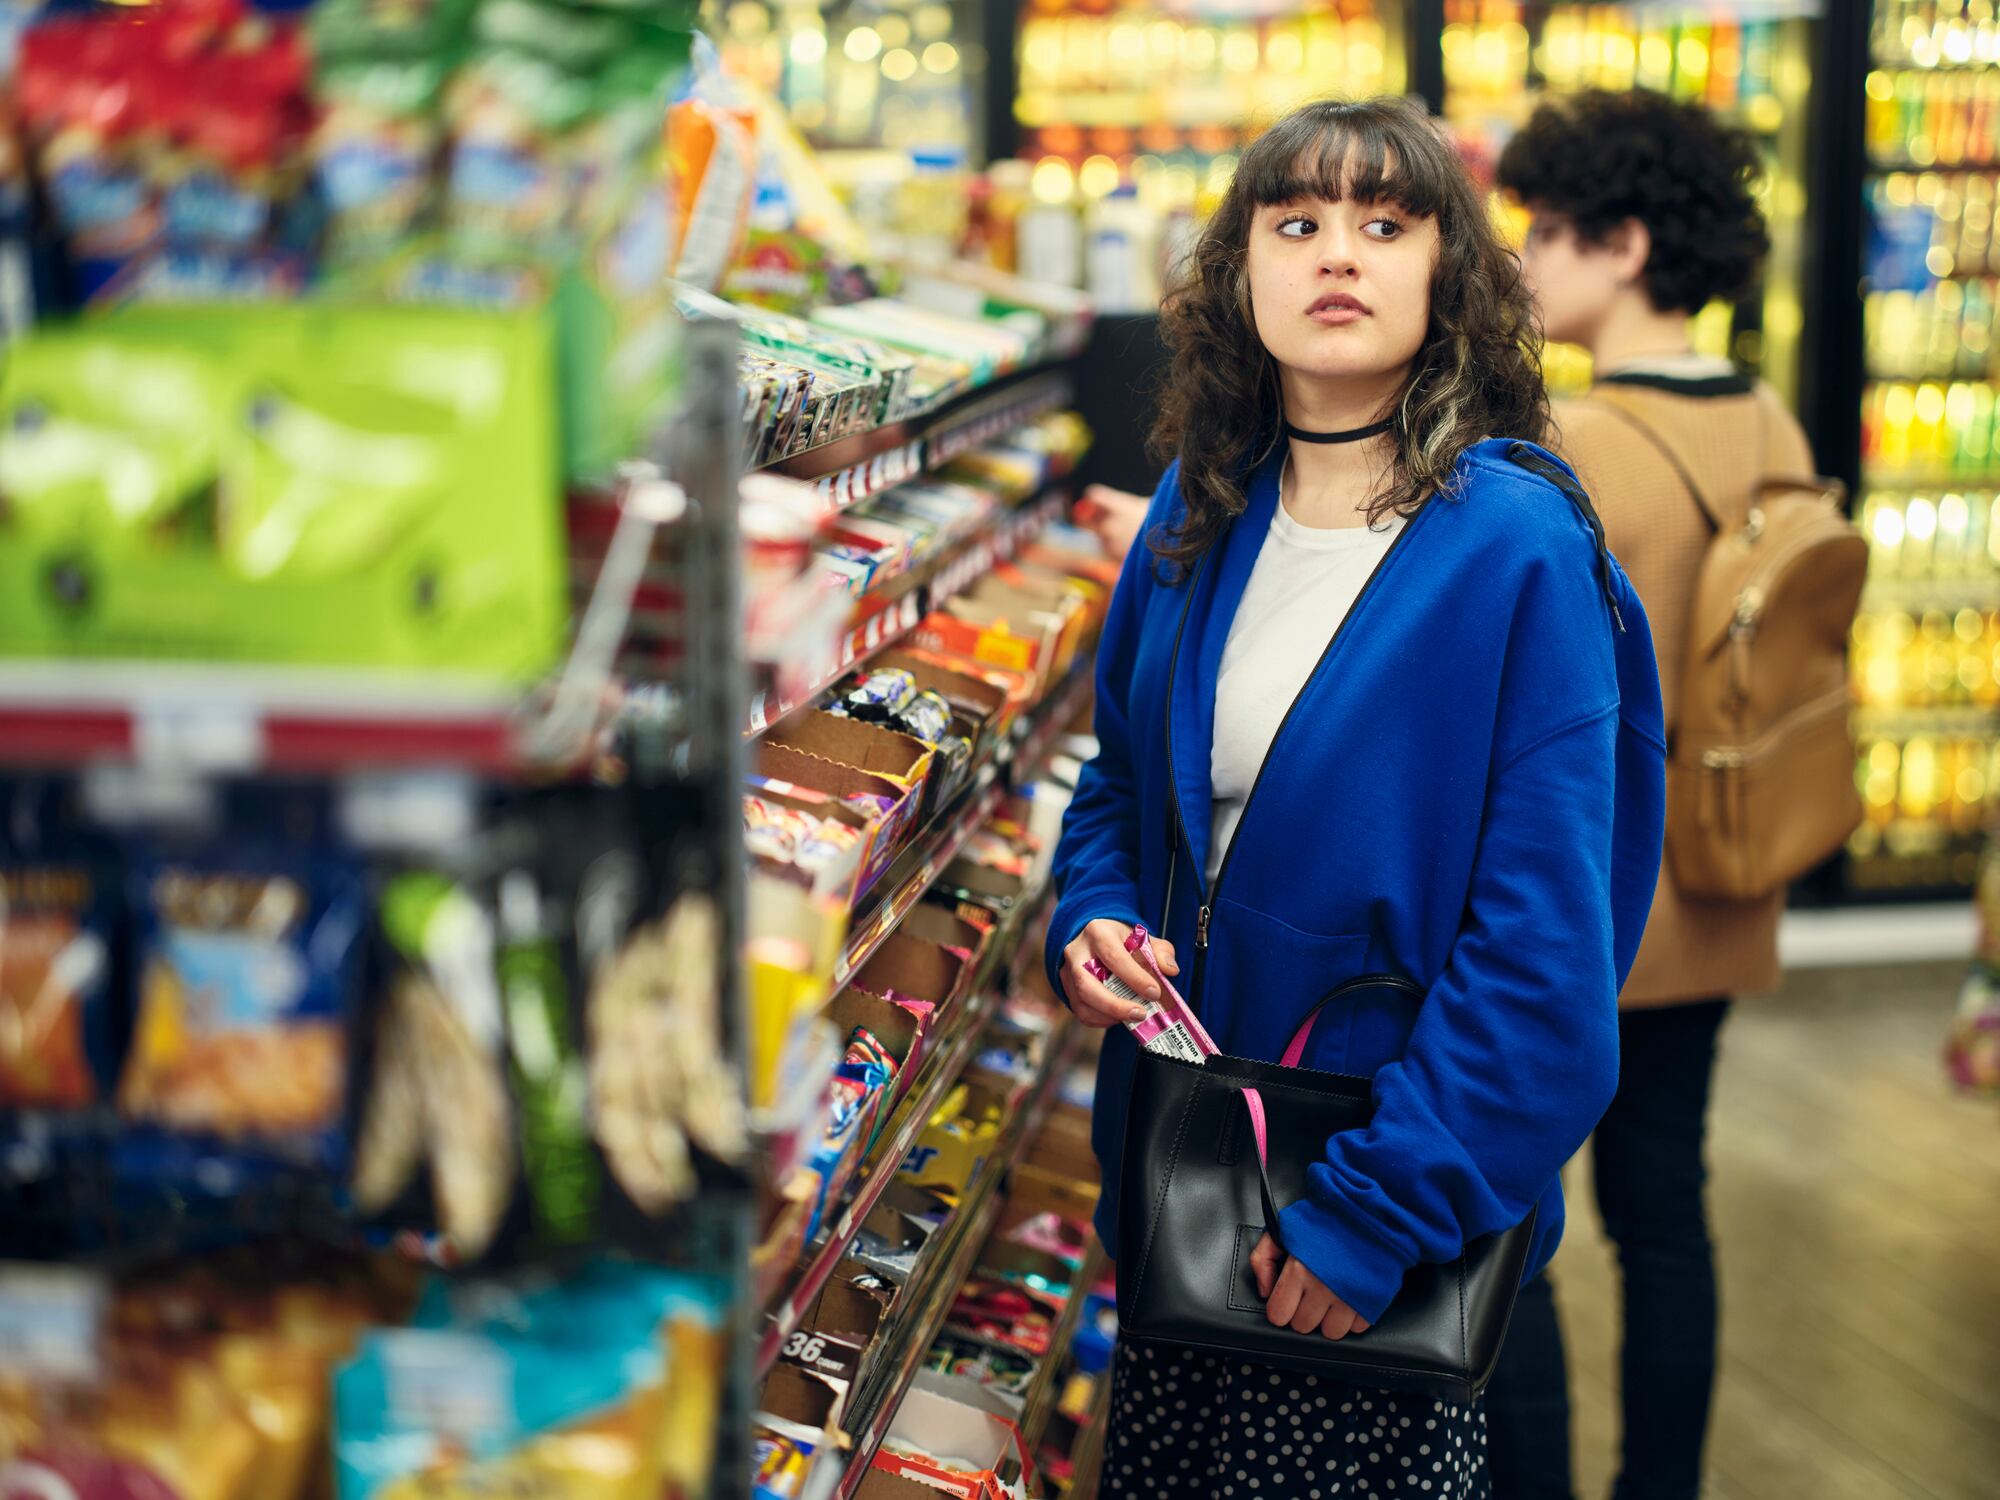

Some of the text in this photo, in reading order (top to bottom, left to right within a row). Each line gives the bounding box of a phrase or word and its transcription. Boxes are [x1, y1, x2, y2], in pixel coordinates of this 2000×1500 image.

[1168, 1029, 1184, 1050] Facts
[1174, 1023, 1199, 1057] Nutrition
[782, 1332, 826, 1362] 36
